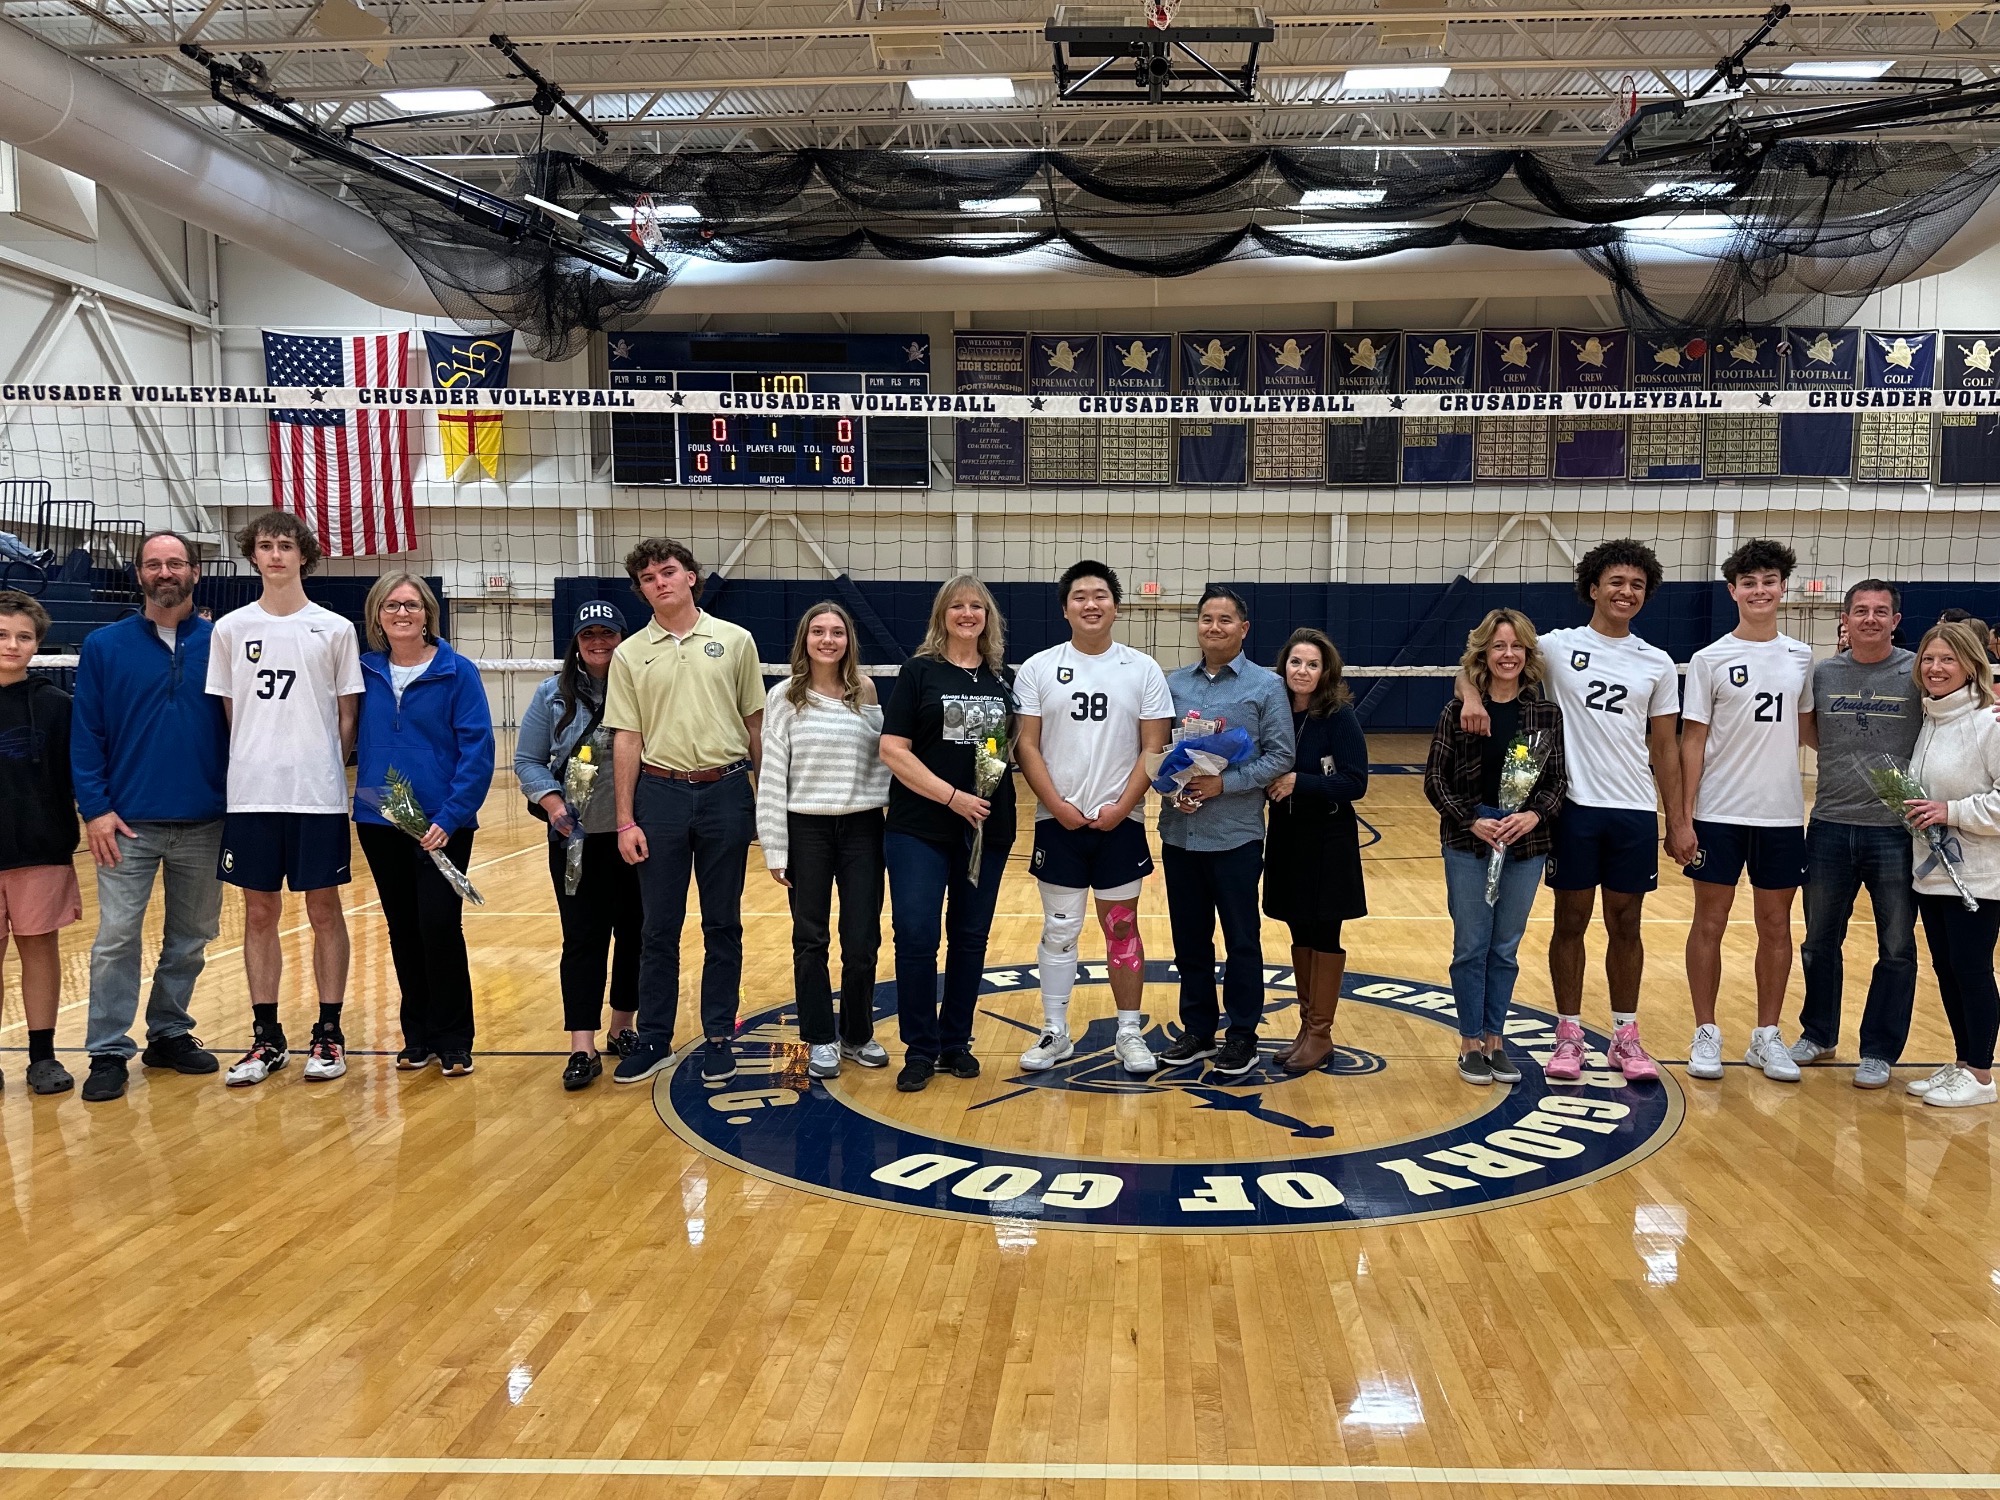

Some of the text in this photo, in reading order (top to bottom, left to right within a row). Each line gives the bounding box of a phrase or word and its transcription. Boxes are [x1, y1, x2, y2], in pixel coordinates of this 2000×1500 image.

[957, 361, 1023, 372] HIGH SCHOOL
[1503, 373, 1527, 382] CREW
[1580, 373, 1604, 382] CREW
[1634, 373, 1703, 383] CROSS COUNTRY
[1715, 369, 1776, 378] FOOTBALL
[1790, 369, 1851, 380] FOOTBALL
[614, 376, 666, 384] PLYR FLS PTS
[761, 376, 803, 393] 1:00
[870, 378, 884, 386] PLYR
[891, 378, 902, 386] FLS
[1031, 378, 1094, 387] SUPREMACY CUP
[1108, 378, 1165, 387] BASEBALL
[1188, 377, 1240, 386] BASEBALL
[1265, 376, 1315, 385] BASKETBALL
[1339, 376, 1390, 385] BASKETBALL
[1415, 376, 1465, 385] BOWLING
[1884, 375, 1913, 384] GOLF
[1963, 378, 1994, 387] GOLF
[957, 383, 1023, 393] SPORTSMANSHIP
[1488, 385, 1542, 393] CHAMPIONS
[1711, 382, 1779, 391] CHAMPIONSHIPS
[1786, 382, 1853, 390] CHAMPIONSHIPS
[3, 384, 277, 403] CRUSADER VOLLEYBALL
[359, 388, 635, 406] CRUSADER VOLLEYBALL
[1264, 388, 1316, 396] CHAMPIONS
[720, 392, 996, 412] CRUSADER VOLLEYBALL
[1440, 392, 1722, 411] CRUSADER VOLLEYBALL
[1808, 391, 1932, 407] CRUSADER
[1079, 396, 1354, 413] CRUSADER VOLLEYBALL
[688, 444, 712, 452] FOULS
[746, 444, 774, 453] PLAYER
[778, 445, 796, 453] FOUL
[1031, 449, 1078, 457] 2012 2015
[688, 475, 856, 484] SCORE MATCH SCORE
[490, 576, 504, 587] EXIT
[580, 604, 614, 620] CHS
[256, 669, 296, 700] 37
[1586, 680, 1628, 714] 22
[1070, 692, 1108, 722] 38
[1754, 692, 1783, 722] 21
[1830, 696, 1901, 712] Crusaders
[1376, 1096, 1630, 1195] GLORY
[870, 1153, 1124, 1209] GOD
[1178, 1172, 1345, 1212] OF
